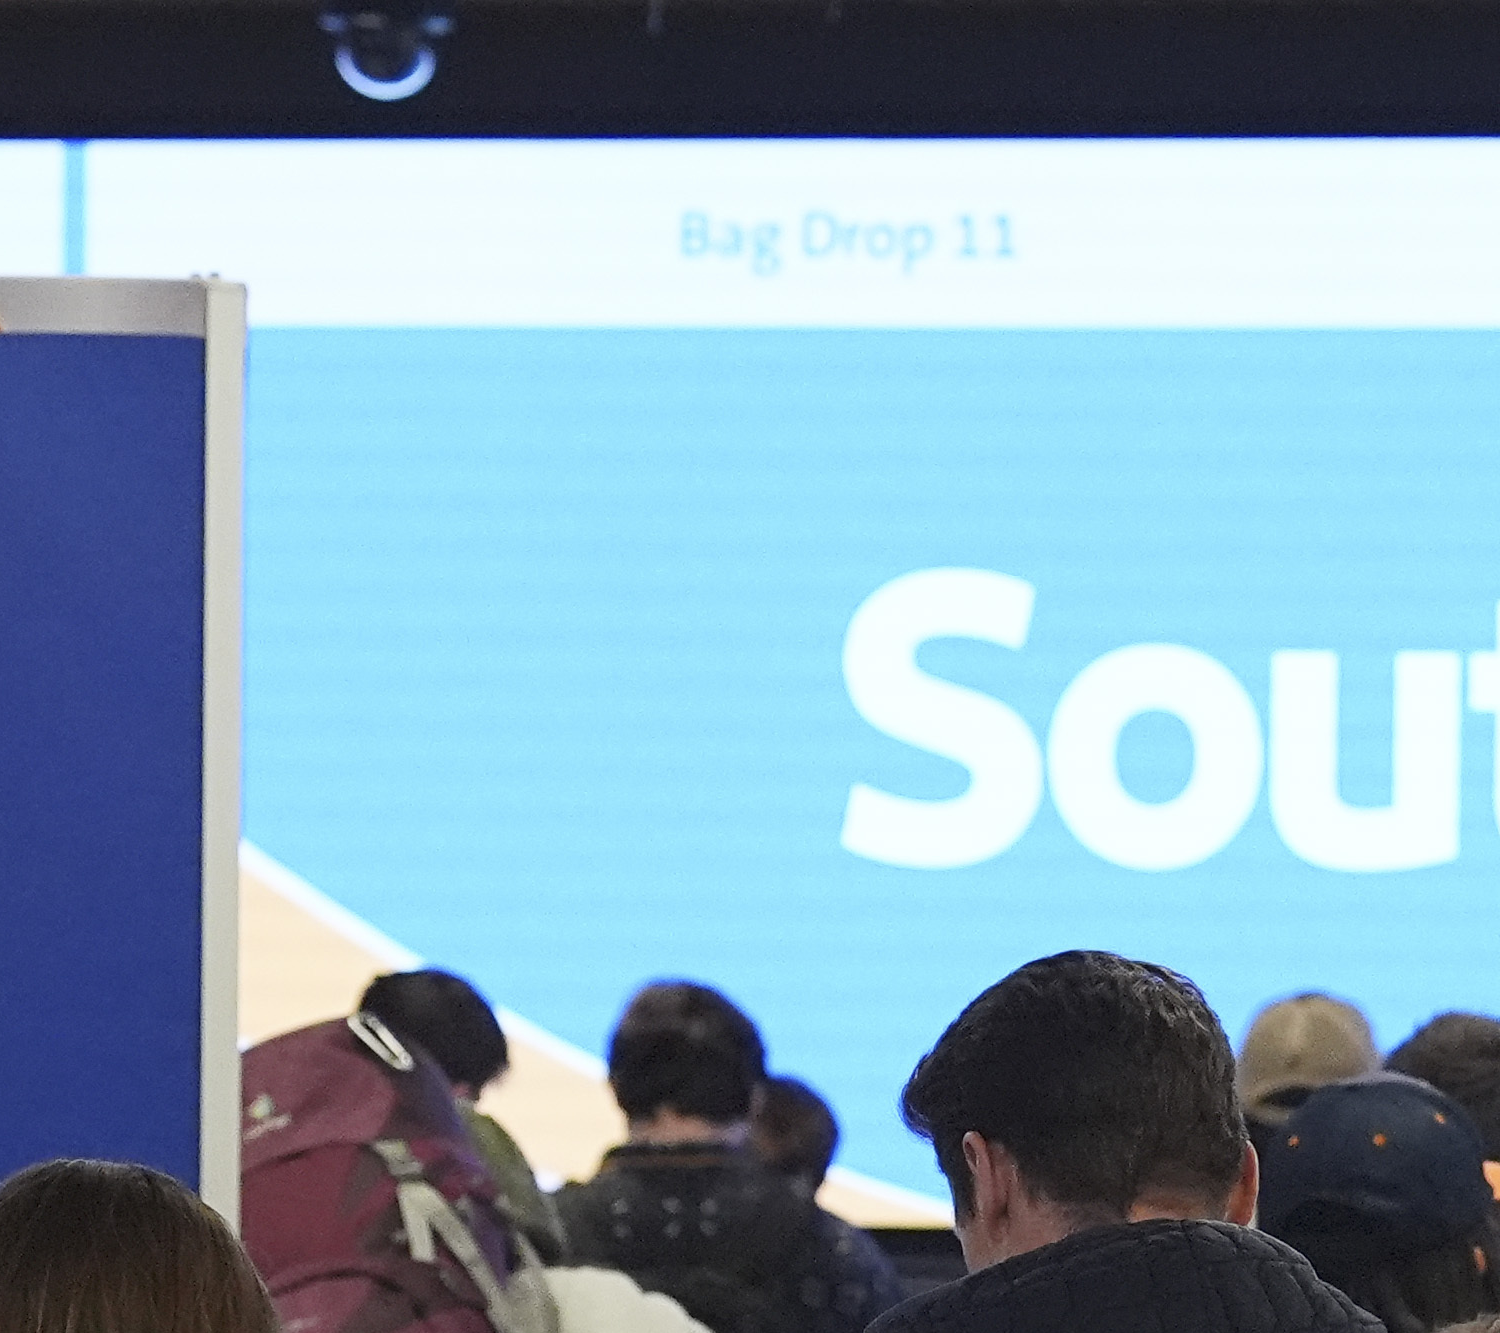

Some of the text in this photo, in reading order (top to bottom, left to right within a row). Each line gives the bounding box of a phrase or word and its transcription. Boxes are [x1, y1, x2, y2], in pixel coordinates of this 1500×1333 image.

[678, 208, 1017, 278] Bag Drop 11
